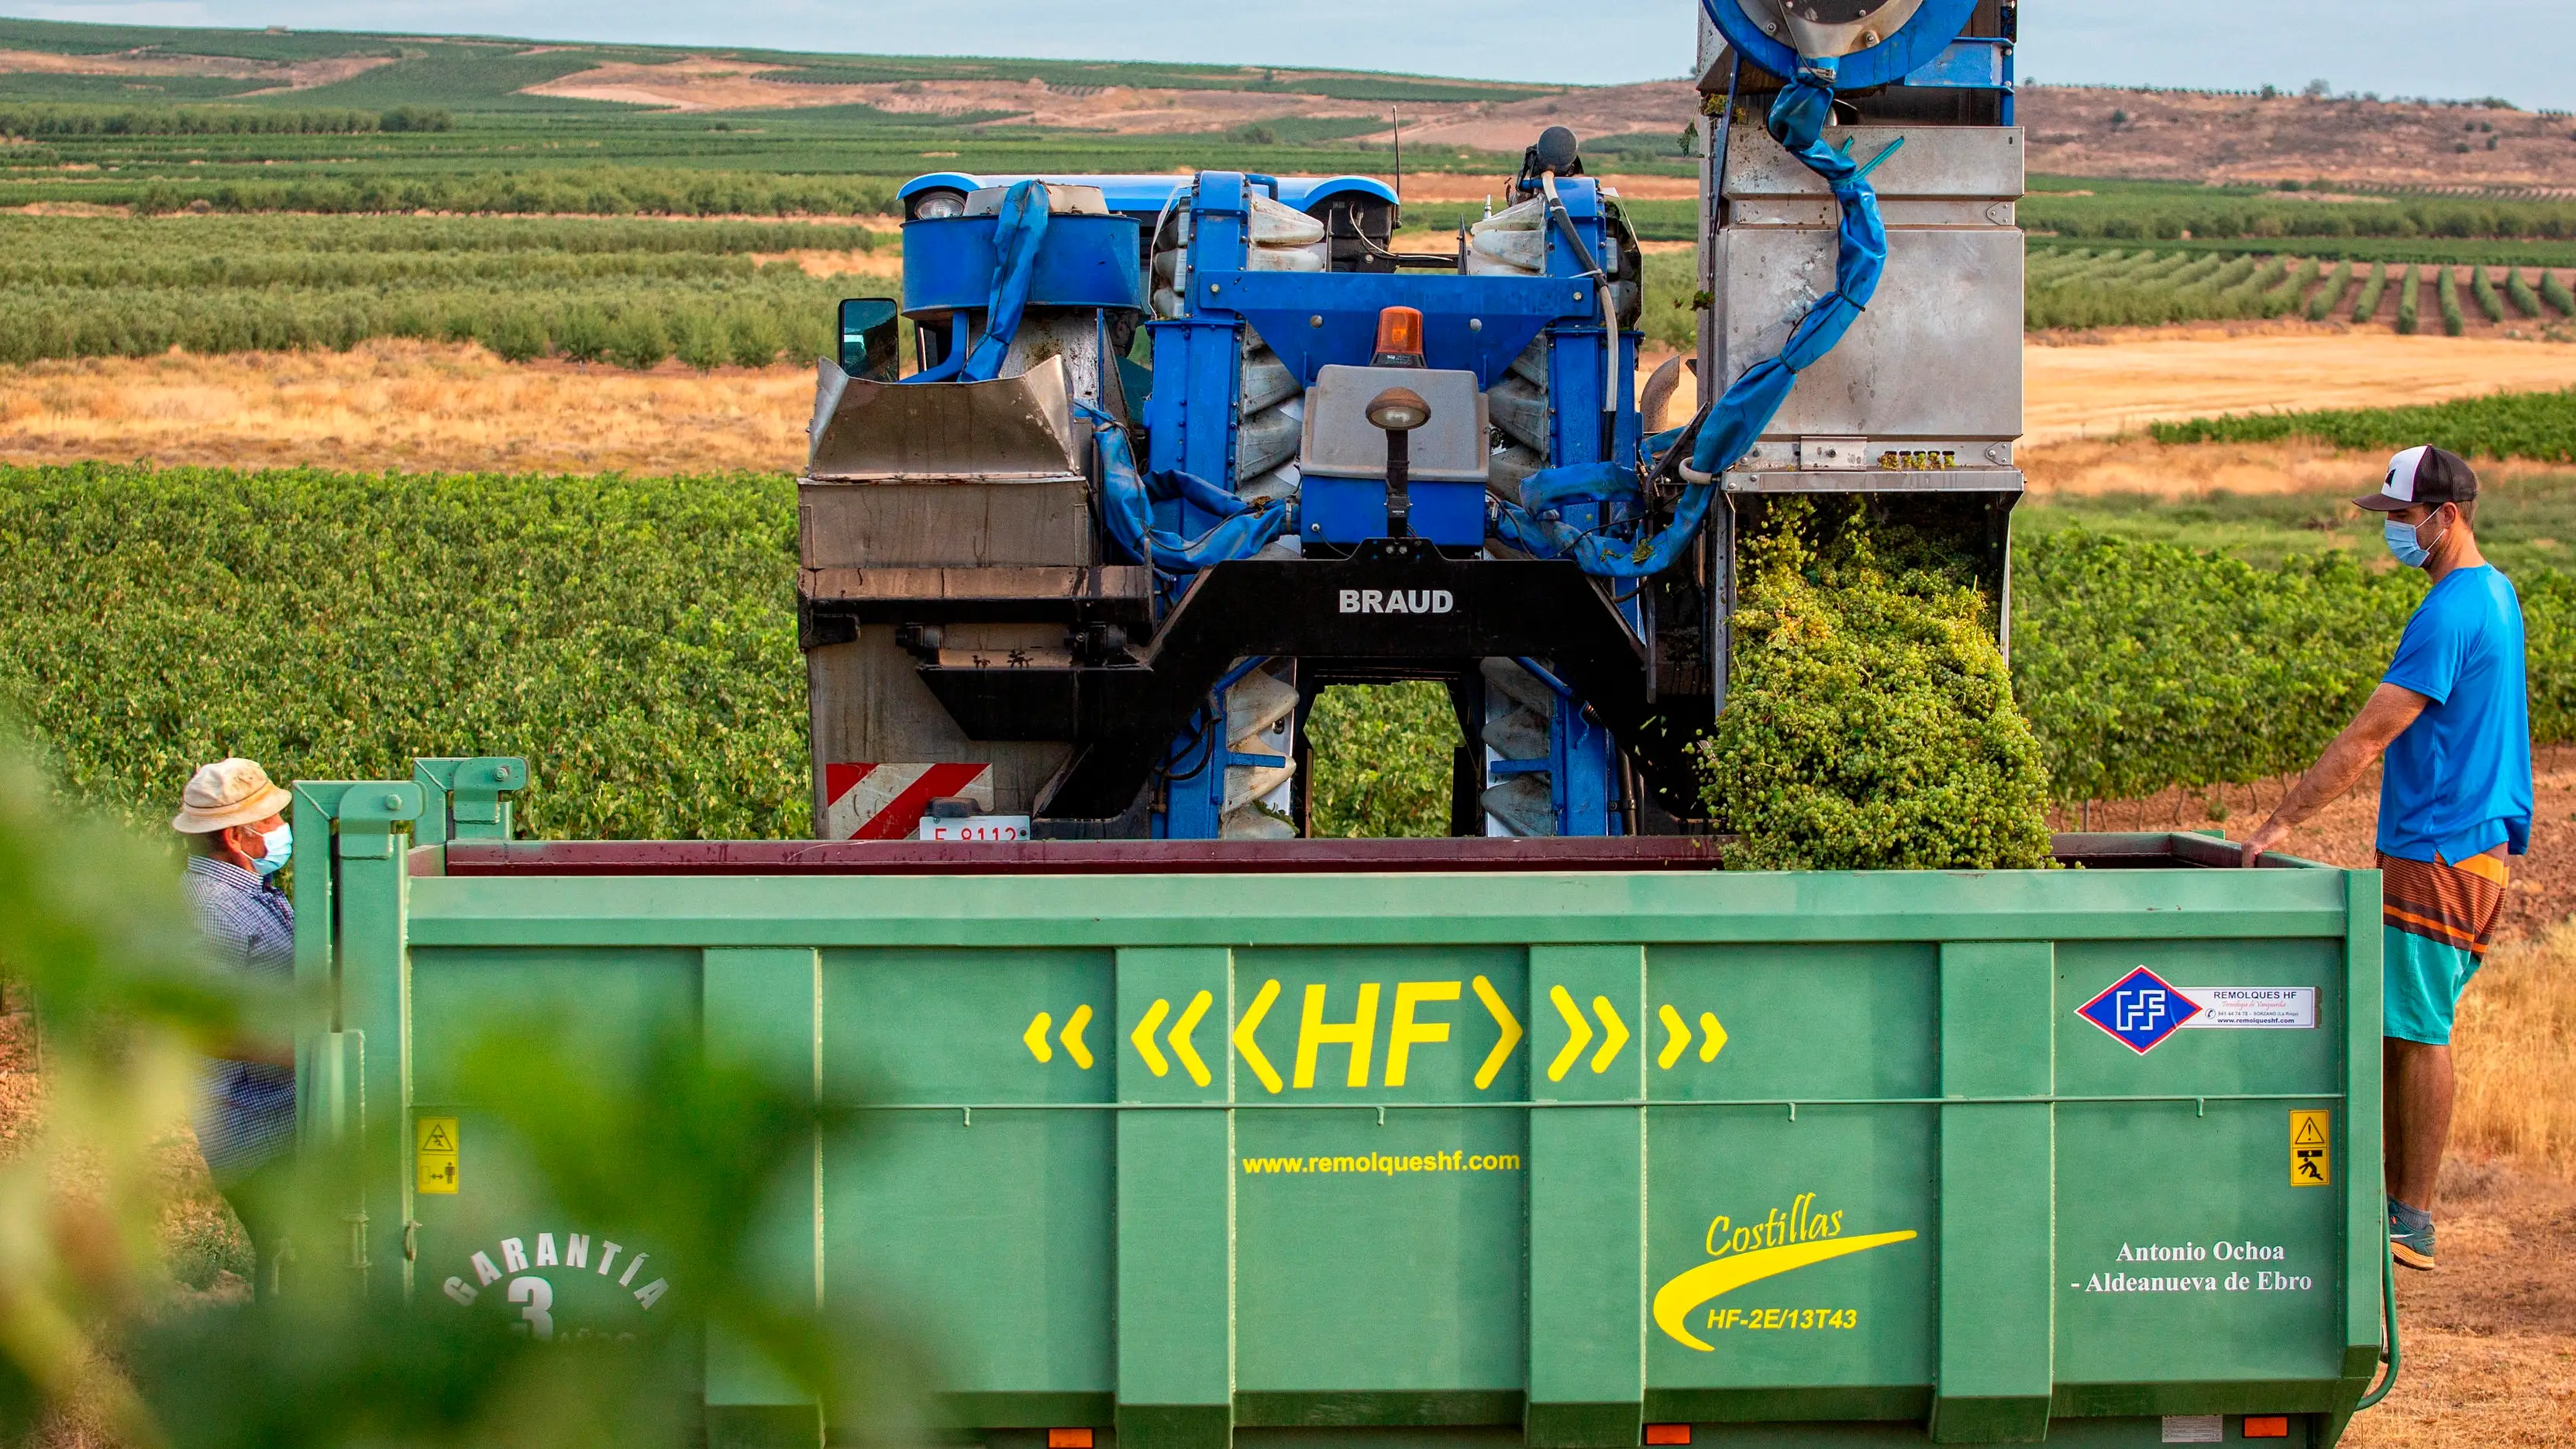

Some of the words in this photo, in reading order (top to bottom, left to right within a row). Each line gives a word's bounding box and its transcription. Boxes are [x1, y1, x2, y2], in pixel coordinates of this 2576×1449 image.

[1339, 590, 1453, 613] BRAUD
[2213, 991, 2280, 1000] REMOLQUES
[1293, 981, 1462, 1088] HF
[1242, 1151, 1520, 1175] www.remolqueshf.com
[1706, 1192, 1843, 1256] Costillas
[2115, 1241, 2206, 1261] Antonio
[2212, 1241, 2285, 1260] Ochoa
[443, 1232, 670, 1310] GARANTÍA
[2085, 1272, 2217, 1292] Aldeanueva
[2223, 1272, 2250, 1291] de
[2256, 1271, 2313, 1291] Ebro
[1706, 1309, 1858, 1330] HF-2E/13T43
